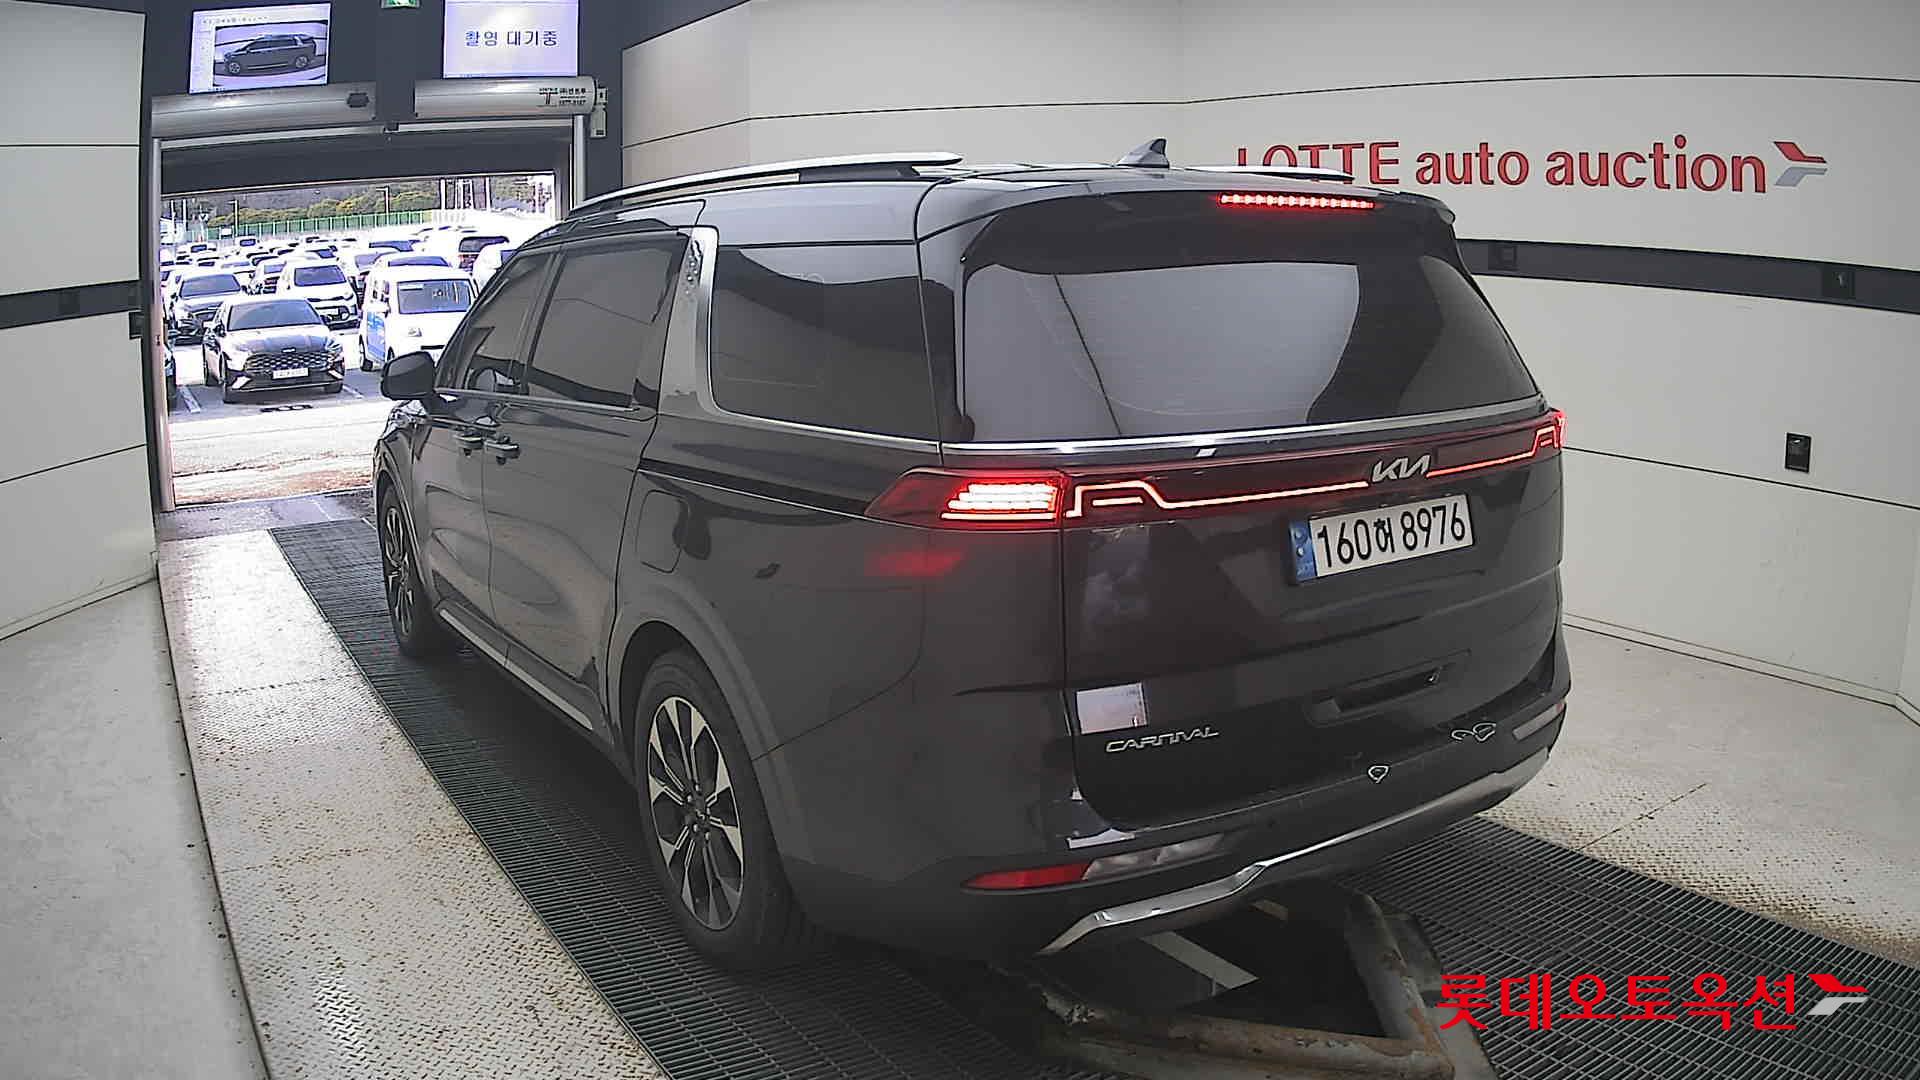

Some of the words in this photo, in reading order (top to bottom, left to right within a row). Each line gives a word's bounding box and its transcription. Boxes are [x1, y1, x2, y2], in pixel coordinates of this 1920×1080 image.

[506, 30, 558, 47] 대기중
[1415, 141, 1530, 186] auto
[1545, 134, 1767, 194] auction
